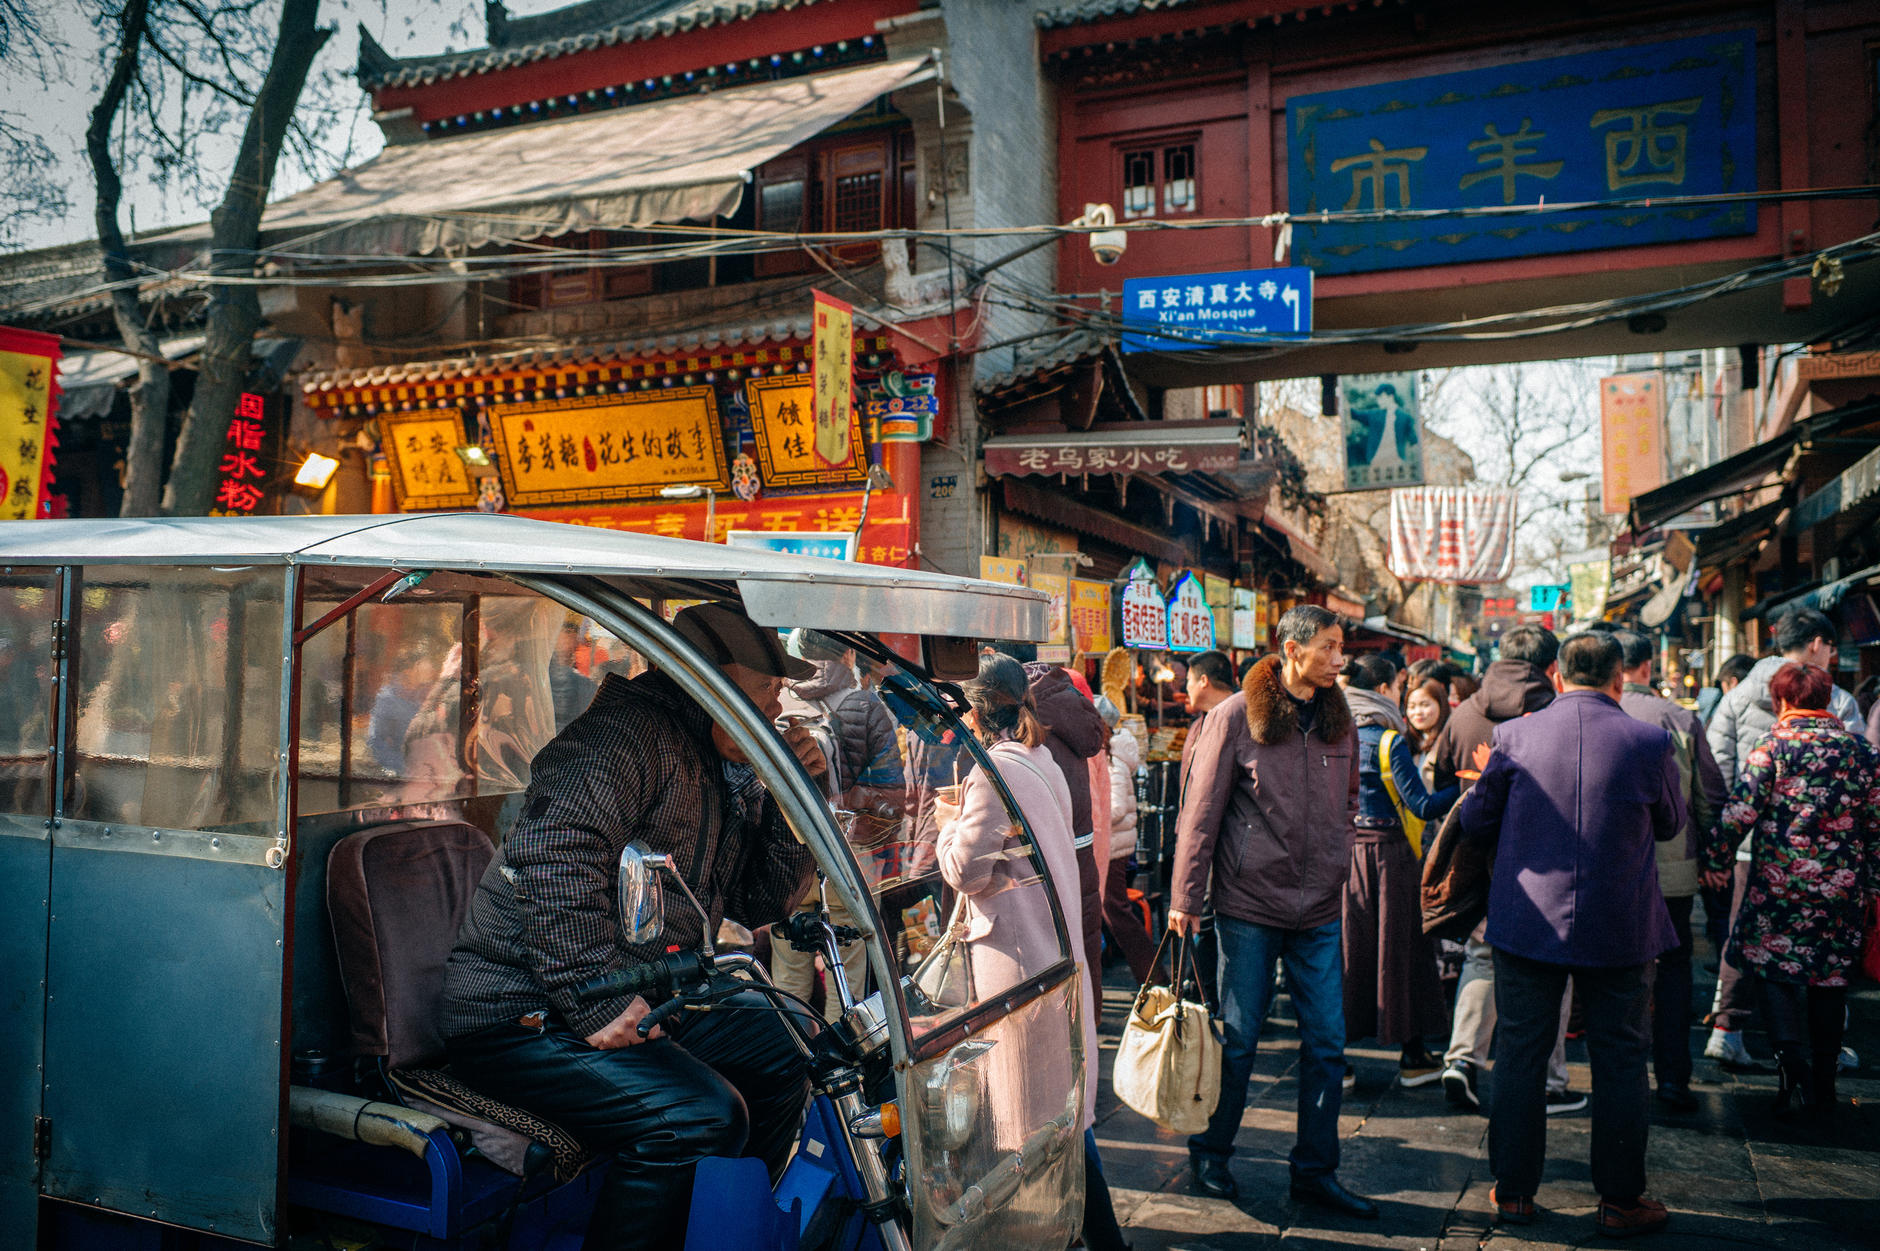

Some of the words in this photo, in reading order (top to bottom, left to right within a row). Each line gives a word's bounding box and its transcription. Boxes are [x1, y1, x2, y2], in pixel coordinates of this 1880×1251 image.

[1138, 280, 1278, 309] 西安清真大寺
[1159, 310, 1194, 322] Xi'an
[1198, 308, 1256, 322] Mosque
